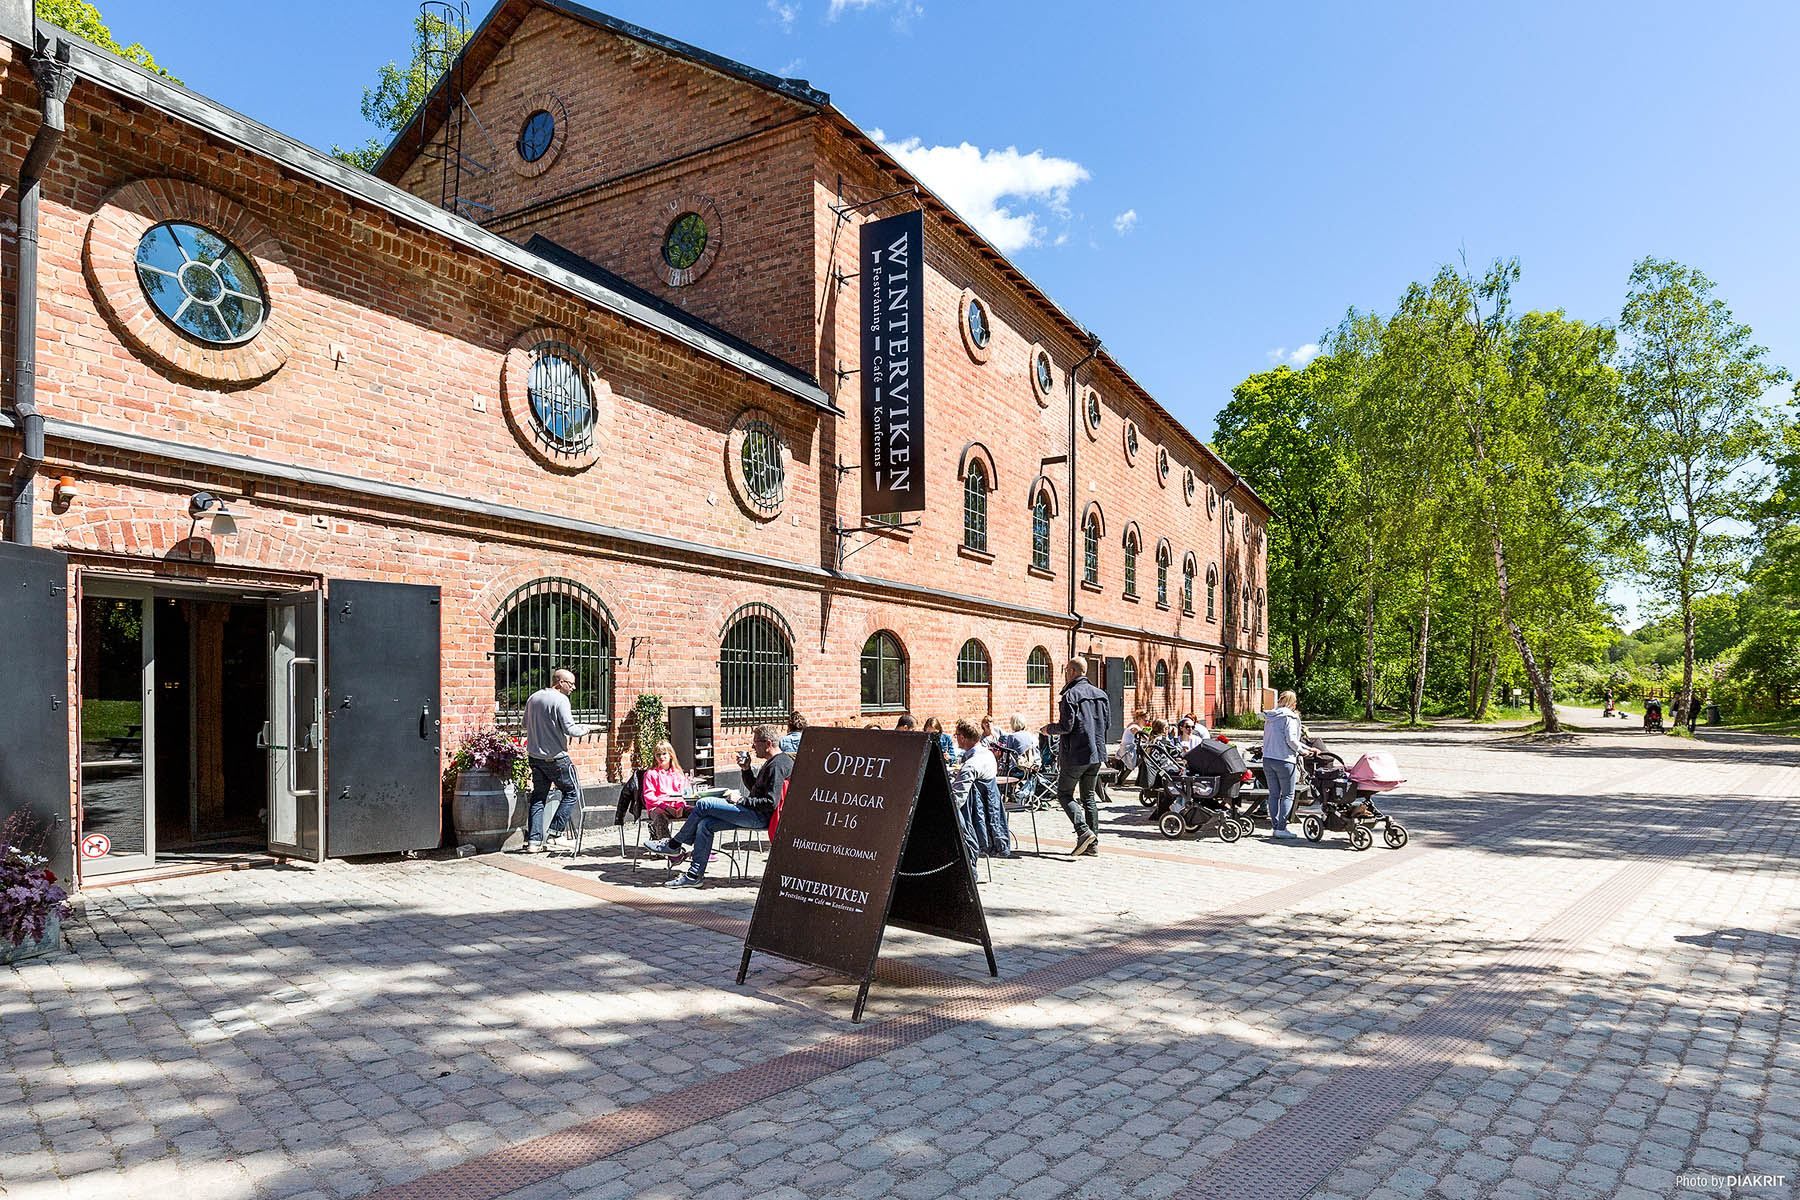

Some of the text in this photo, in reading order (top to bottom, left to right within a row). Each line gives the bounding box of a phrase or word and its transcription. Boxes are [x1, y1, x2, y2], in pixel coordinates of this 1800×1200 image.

[871, 267, 884, 467] Festvåning Café Konferens
[888, 232, 910, 492] WINTERVIKEN
[824, 747, 891, 779] ÖPPET
[810, 787, 884, 809] ALLA DAGAR
[824, 811, 858, 829] 11-16
[792, 838, 878, 861] HJÄRTLIGT VÄLKOMNA!
[780, 875, 870, 905] WINTERVIKEN
